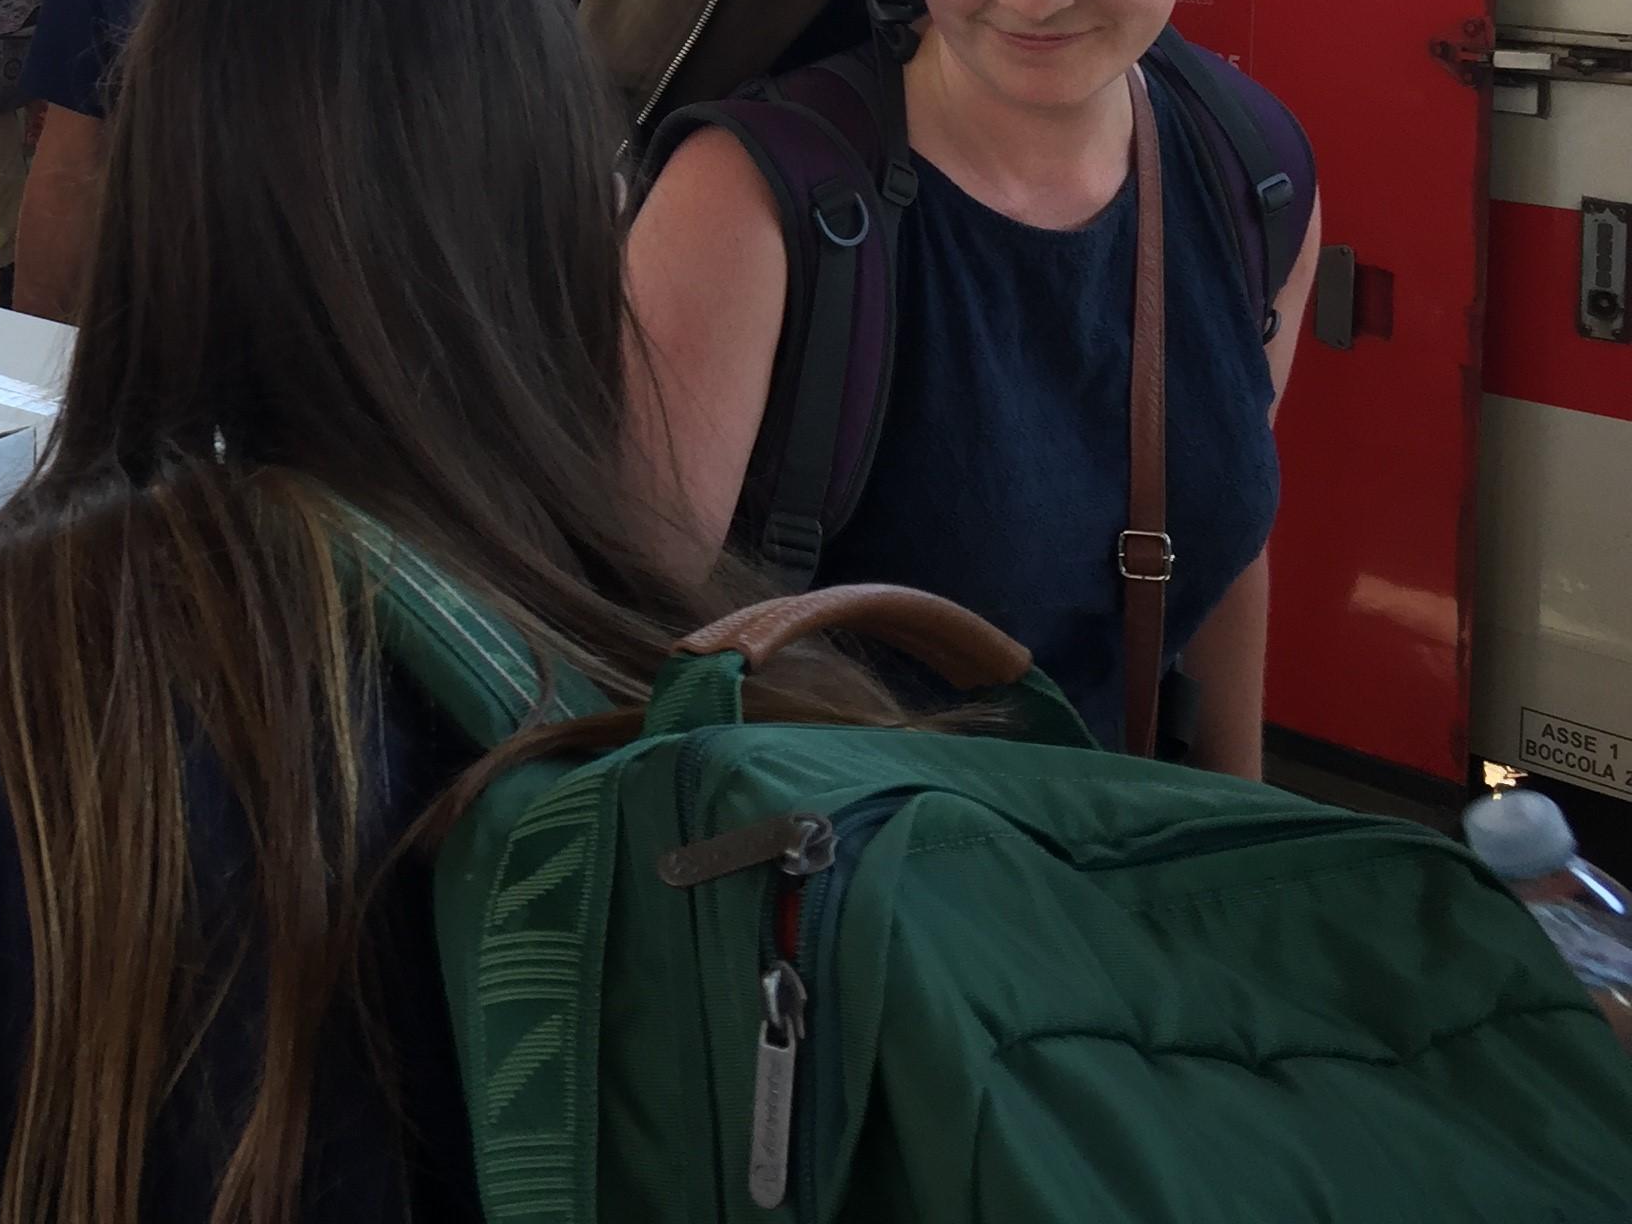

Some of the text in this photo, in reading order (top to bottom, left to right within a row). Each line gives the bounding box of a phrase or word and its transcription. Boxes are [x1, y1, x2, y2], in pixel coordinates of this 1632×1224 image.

[1525, 738, 1616, 782] BOCCOLA
[1541, 722, 1618, 760] ASSE 1
